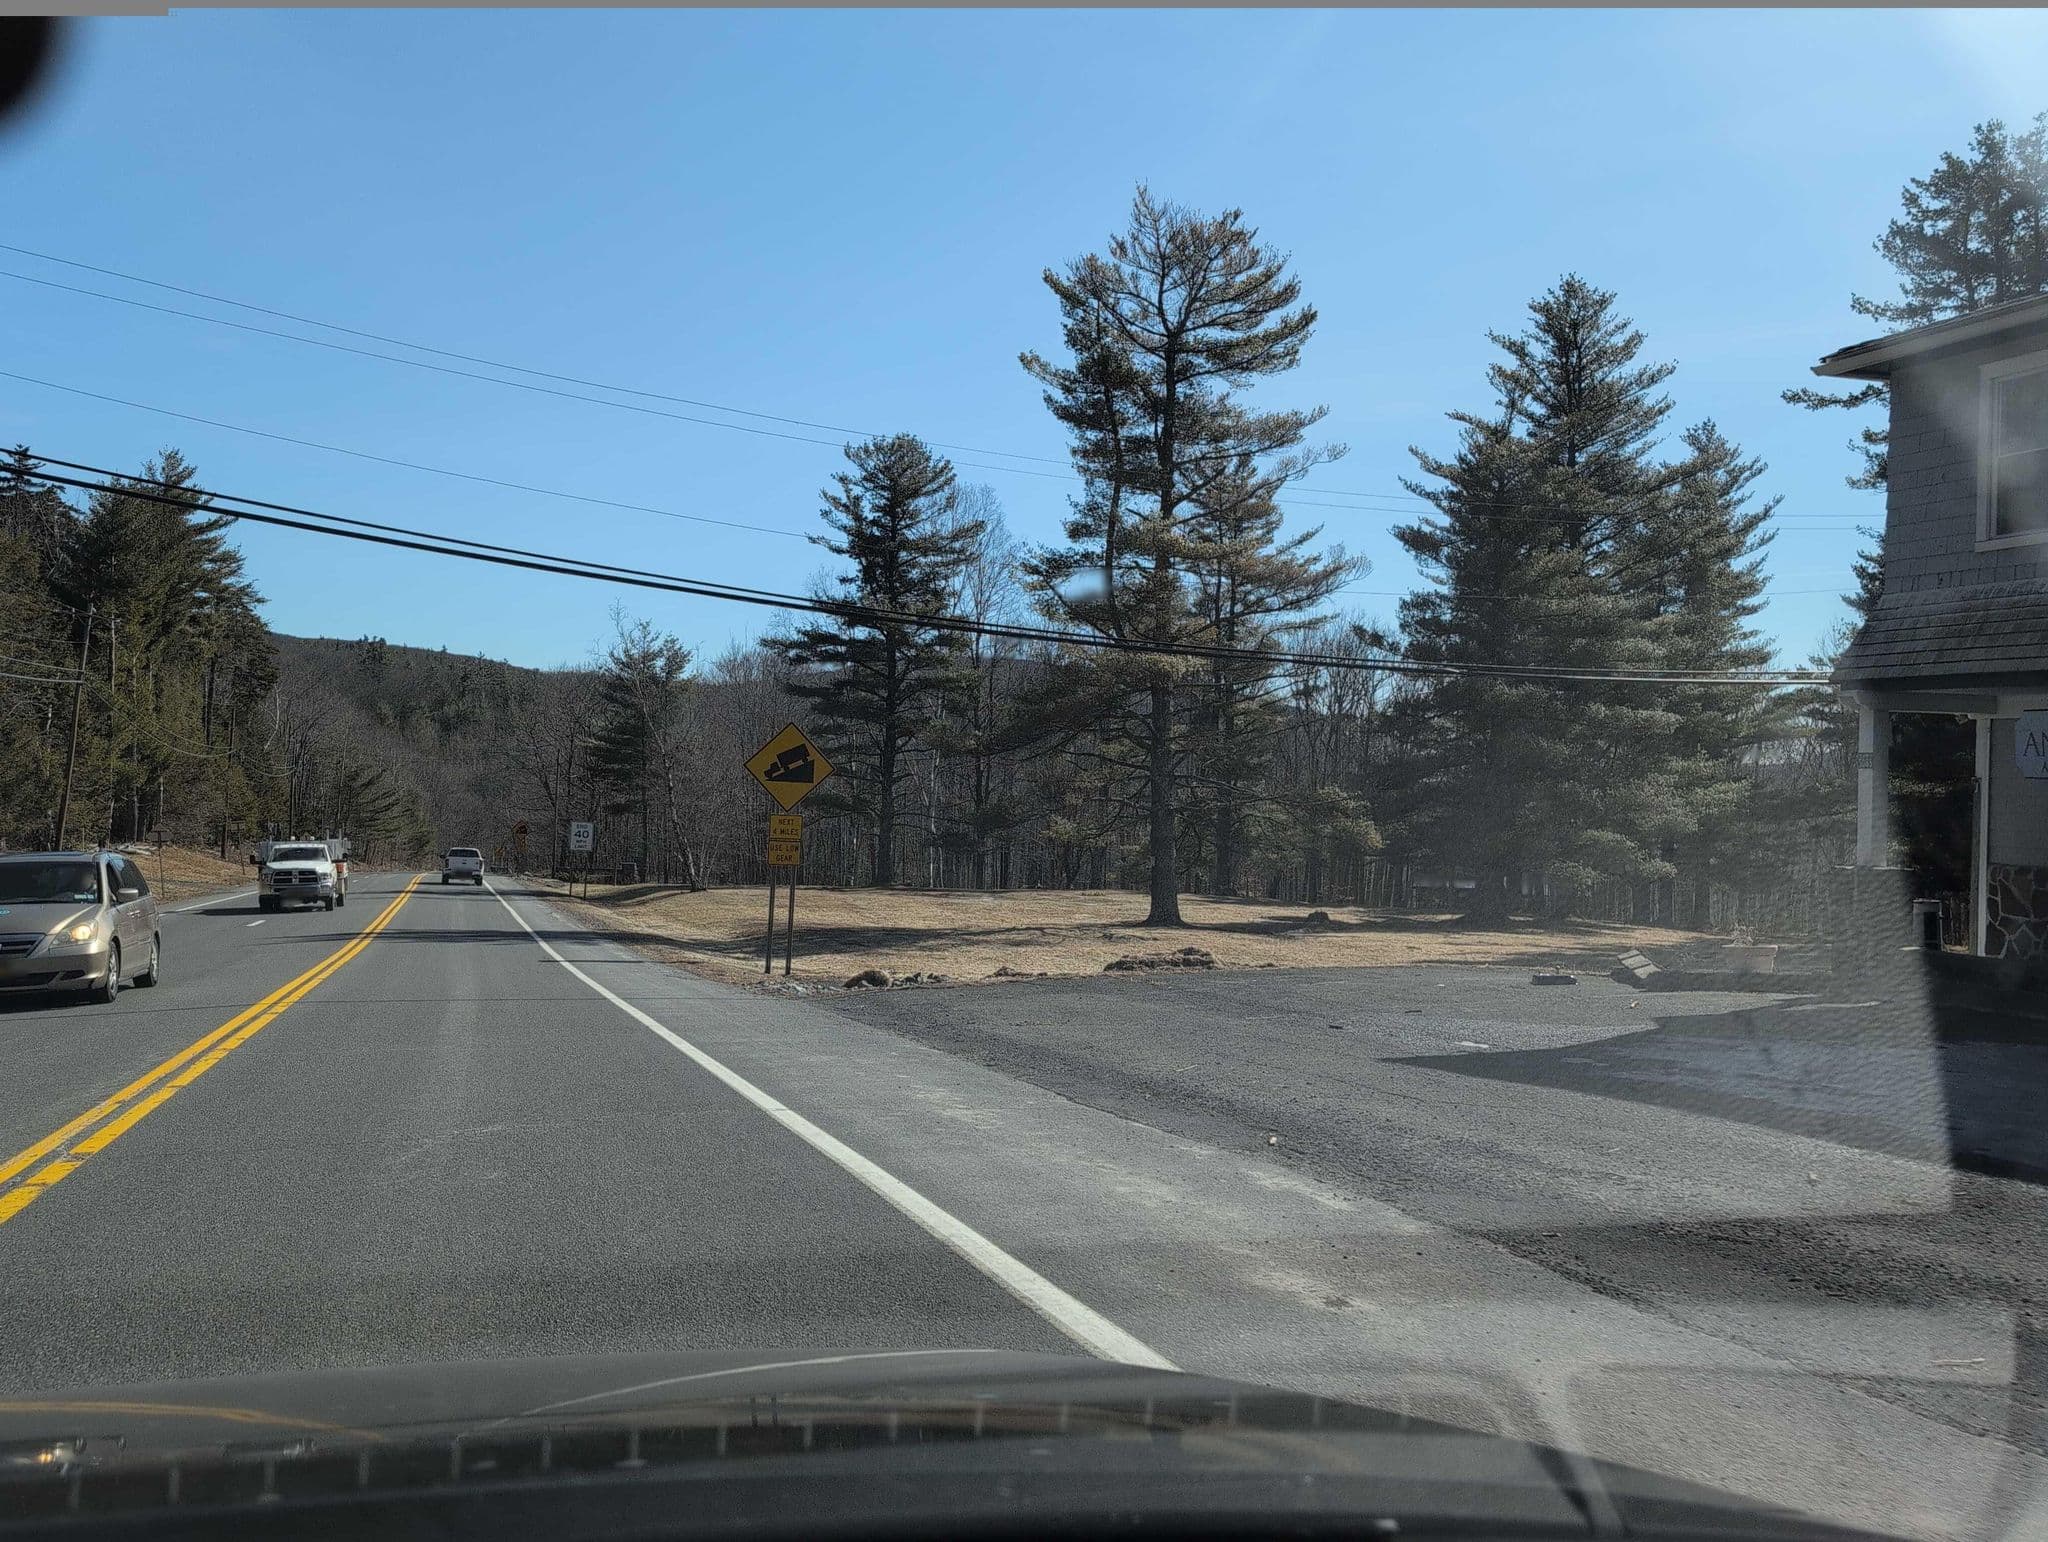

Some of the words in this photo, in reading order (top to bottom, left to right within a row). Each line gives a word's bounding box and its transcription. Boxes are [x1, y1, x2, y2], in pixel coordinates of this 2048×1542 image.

[778, 818, 794, 826] NEXT
[574, 830, 590, 838] 40
[780, 828, 800, 836] MILES
[770, 844, 782, 852] USE
[775, 854, 793, 862] GEAR
